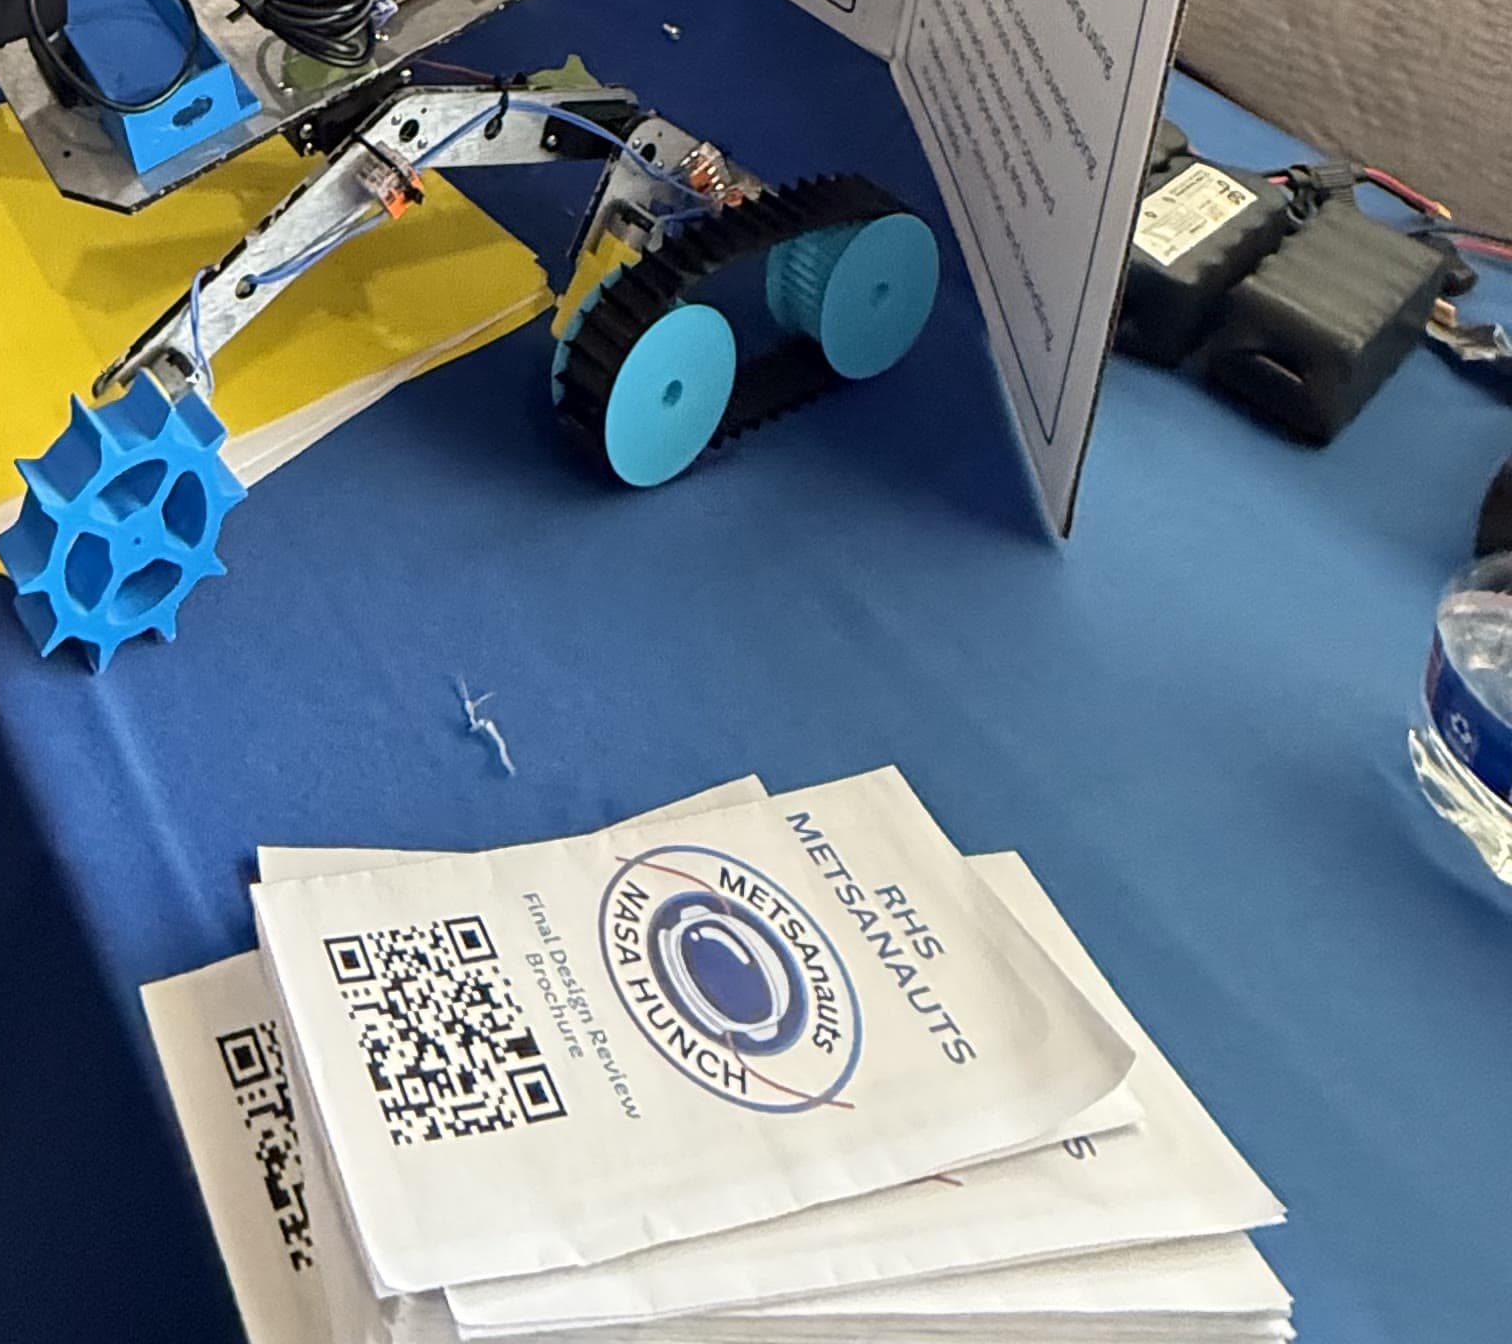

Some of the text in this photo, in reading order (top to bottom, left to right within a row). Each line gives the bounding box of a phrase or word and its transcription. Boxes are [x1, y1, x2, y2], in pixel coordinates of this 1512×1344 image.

[522, 892, 641, 1120] Final Design Review
[525, 952, 584, 1060] Brochure
[613, 880, 747, 1095] NASA HUNCH
[719, 866, 841, 1055] METSAnauts
[786, 812, 977, 1065] METSANAUTS
[874, 884, 944, 960] RHS
